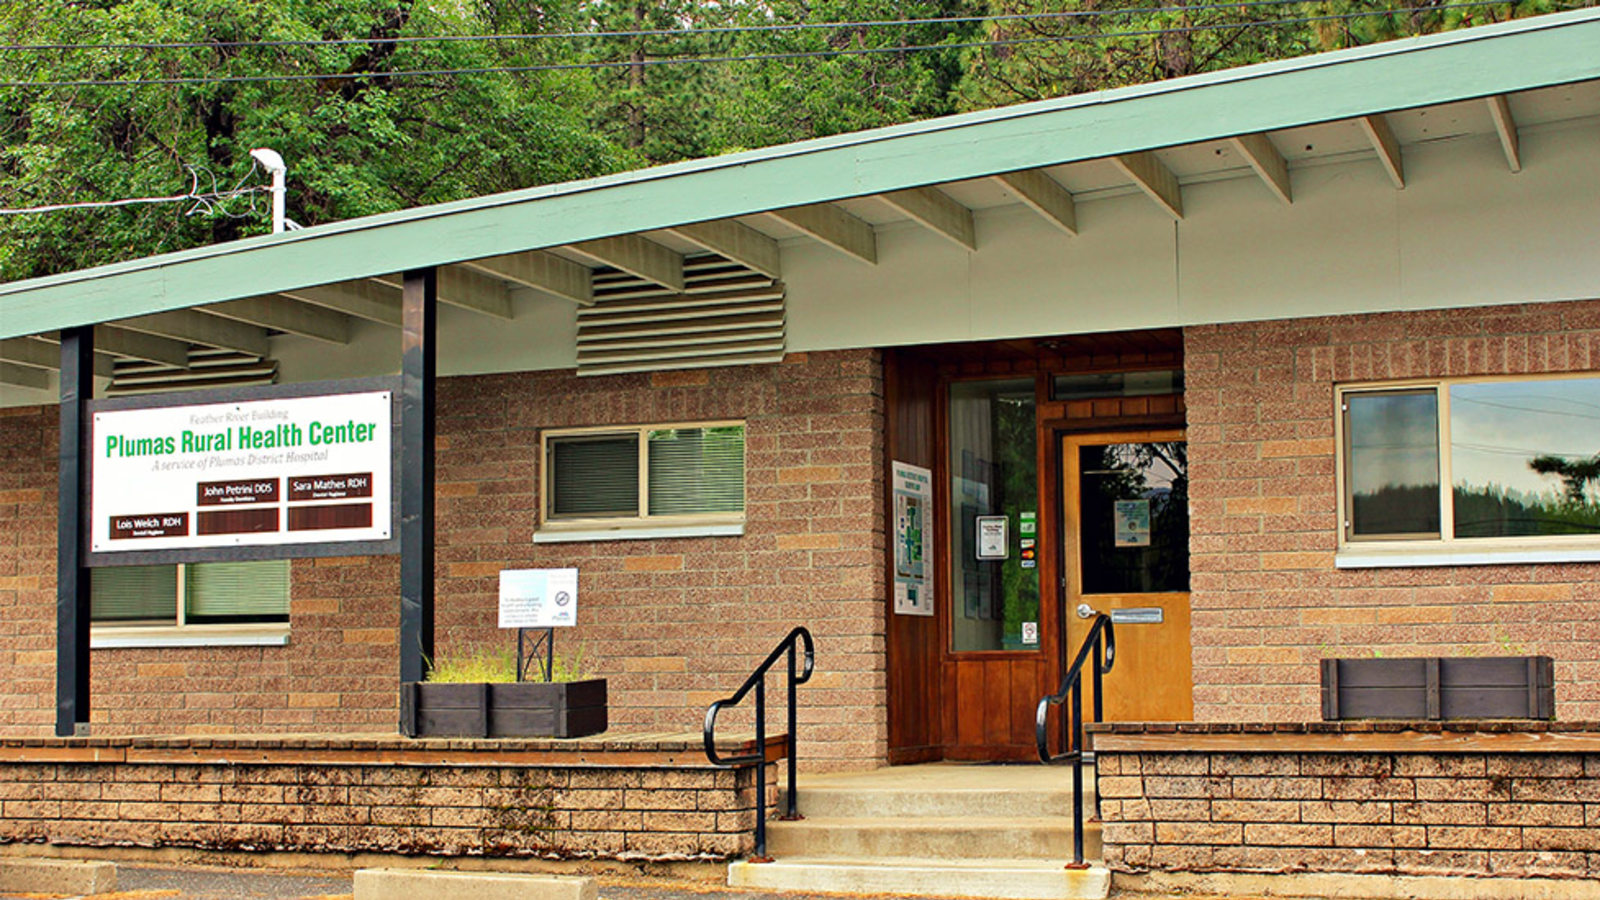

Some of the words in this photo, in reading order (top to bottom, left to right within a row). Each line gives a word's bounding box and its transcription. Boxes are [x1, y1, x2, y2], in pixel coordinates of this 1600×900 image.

[190, 412, 223, 426] Feather
[226, 410, 249, 423] River
[252, 409, 290, 422] Building
[106, 435, 176, 458] Plumas
[182, 428, 232, 453] Rural
[239, 423, 302, 449] Health
[309, 420, 377, 446] Center
[152, 460, 161, 471] A
[162, 459, 195, 470] service
[197, 456, 208, 470] of
[209, 455, 245, 469] Plumas
[247, 452, 284, 466] District
[286, 449, 329, 465] Hospital
[204, 484, 224, 497] John
[225, 483, 253, 496] Petrini
[255, 482, 273, 494] DDS
[293, 480, 312, 492] Sara
[314, 478, 346, 490] Mathes
[347, 477, 367, 489] RDH
[116, 519, 132, 530] Lois
[133, 517, 160, 529] Welch
[162, 516, 182, 528] RDH
